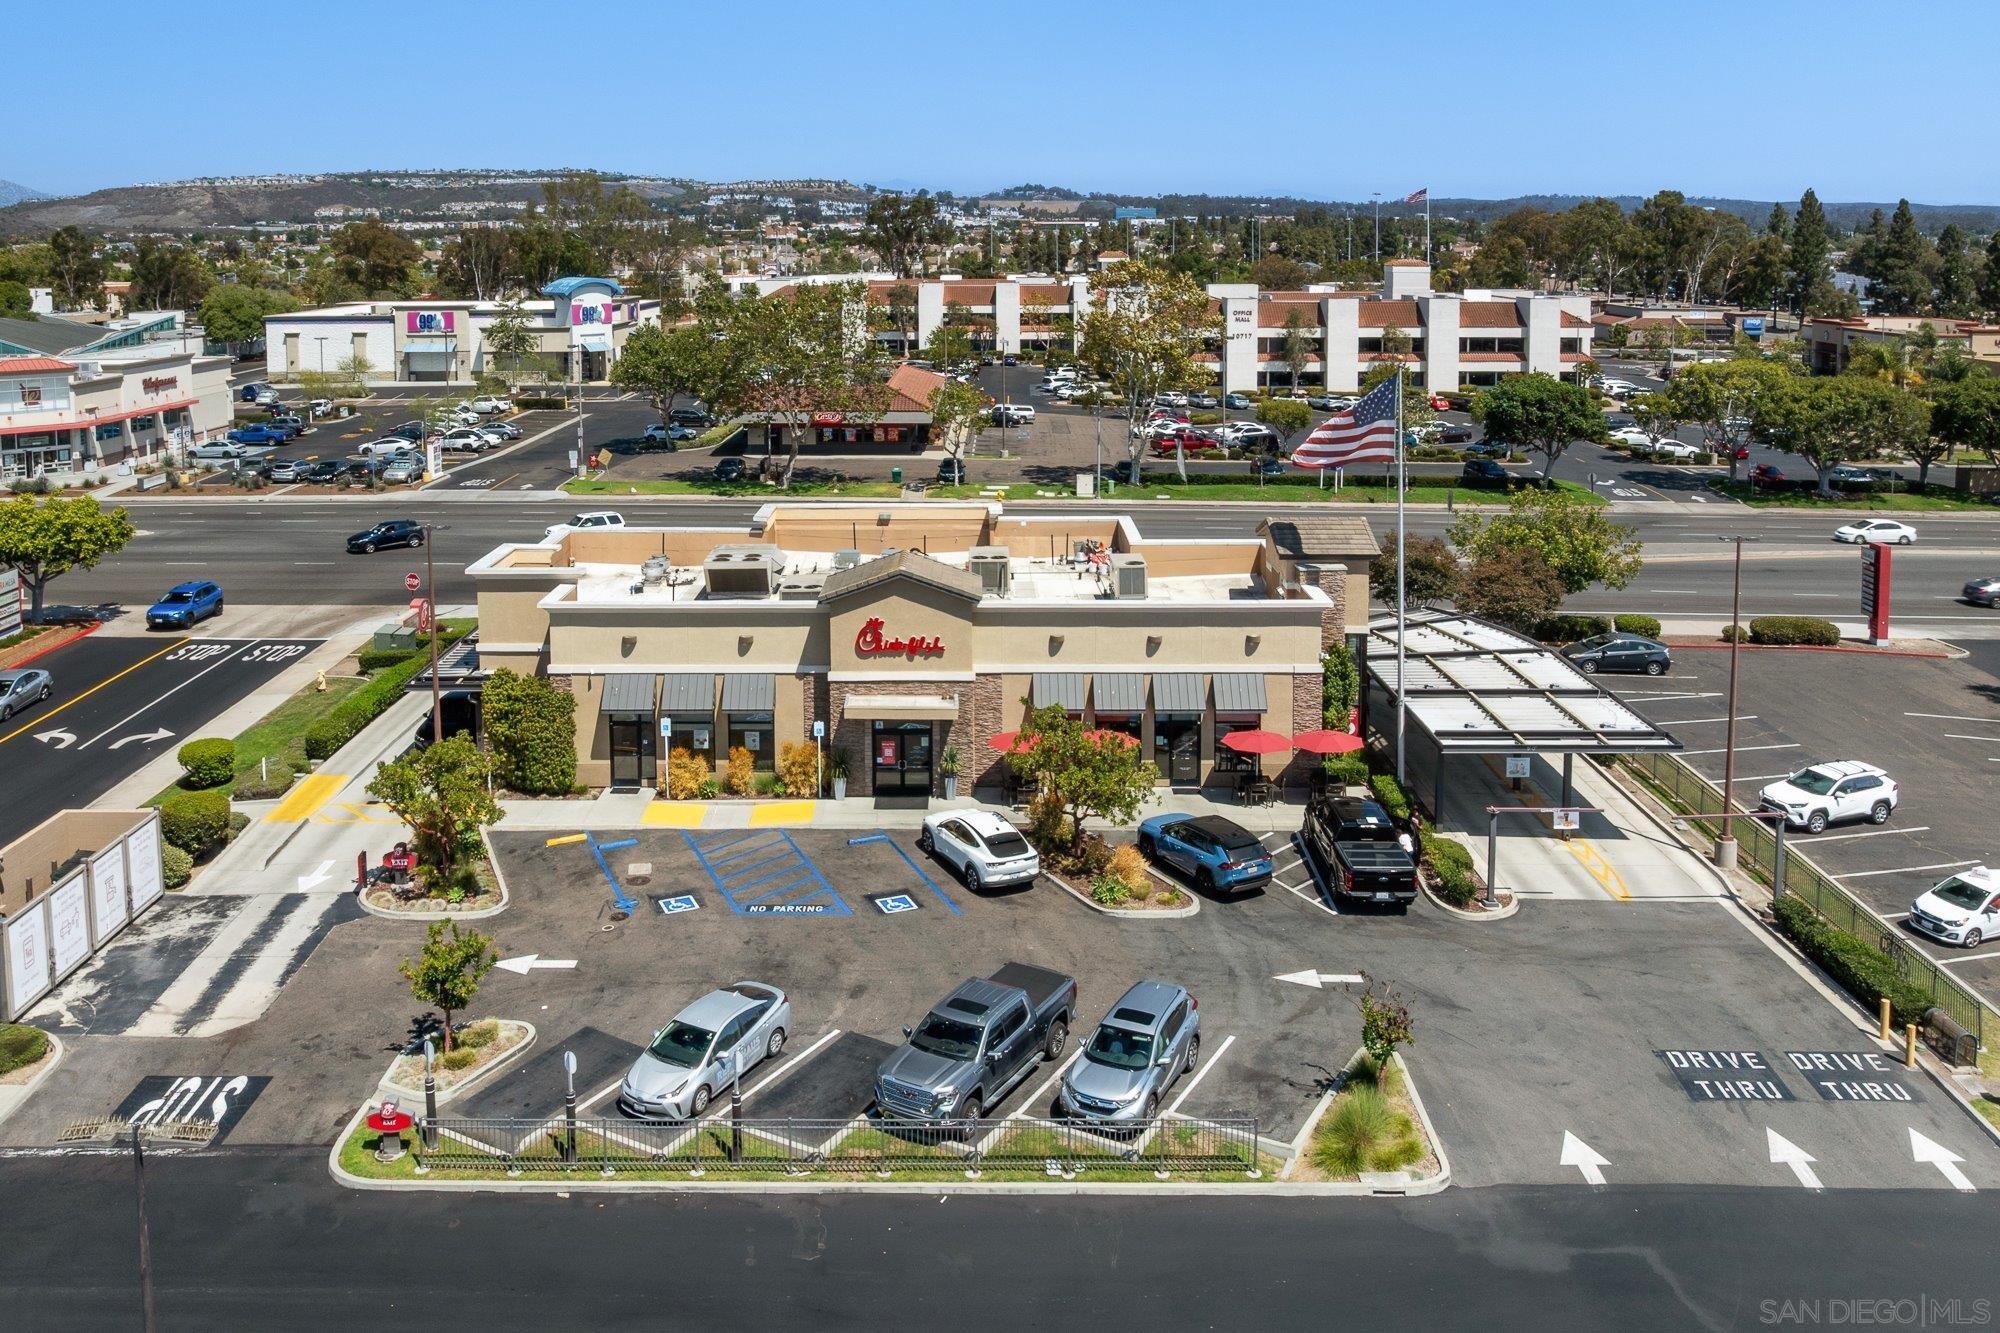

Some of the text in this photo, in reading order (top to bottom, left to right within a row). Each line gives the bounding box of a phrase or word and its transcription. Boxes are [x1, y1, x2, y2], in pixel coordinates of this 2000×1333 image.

[406, 578, 419, 586] STOP
[166, 644, 232, 660] STOP
[242, 645, 306, 662] STOP
[1666, 1051, 1766, 1070] DRIVE
[1787, 1052, 1890, 1071] DRIVE
[1694, 1080, 1783, 1099] THRU
[1820, 1081, 1912, 1100] THRU
